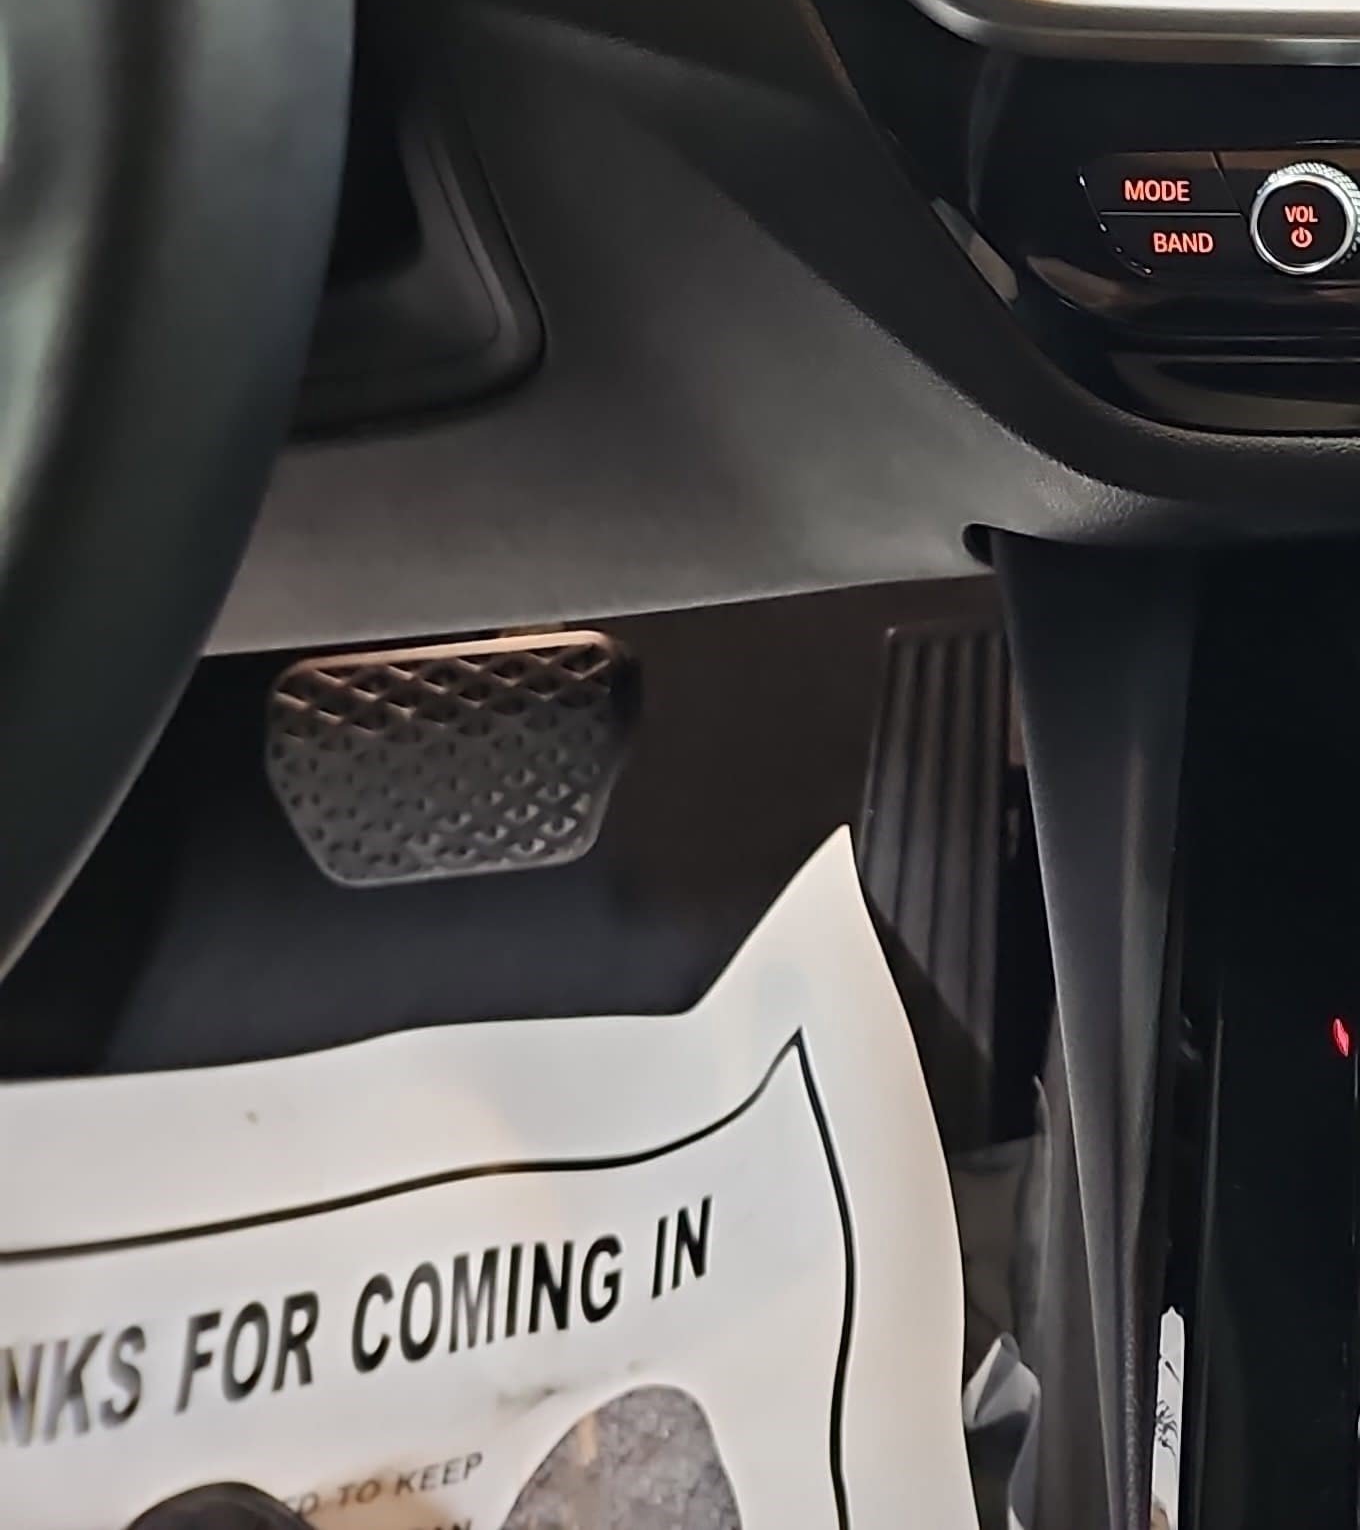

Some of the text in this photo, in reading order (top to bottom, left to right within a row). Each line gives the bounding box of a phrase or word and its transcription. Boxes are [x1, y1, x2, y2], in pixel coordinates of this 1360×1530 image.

[1124, 178, 1191, 203] MODE
[1284, 205, 1319, 224] VOL
[1153, 231, 1214, 254] BAND
[174, 1291, 321, 1414] FOR
[351, 1236, 622, 1372] COMING
[651, 1196, 713, 1298] IN
[337, 1479, 381, 1506] TO
[394, 1451, 484, 1497] KEEP
